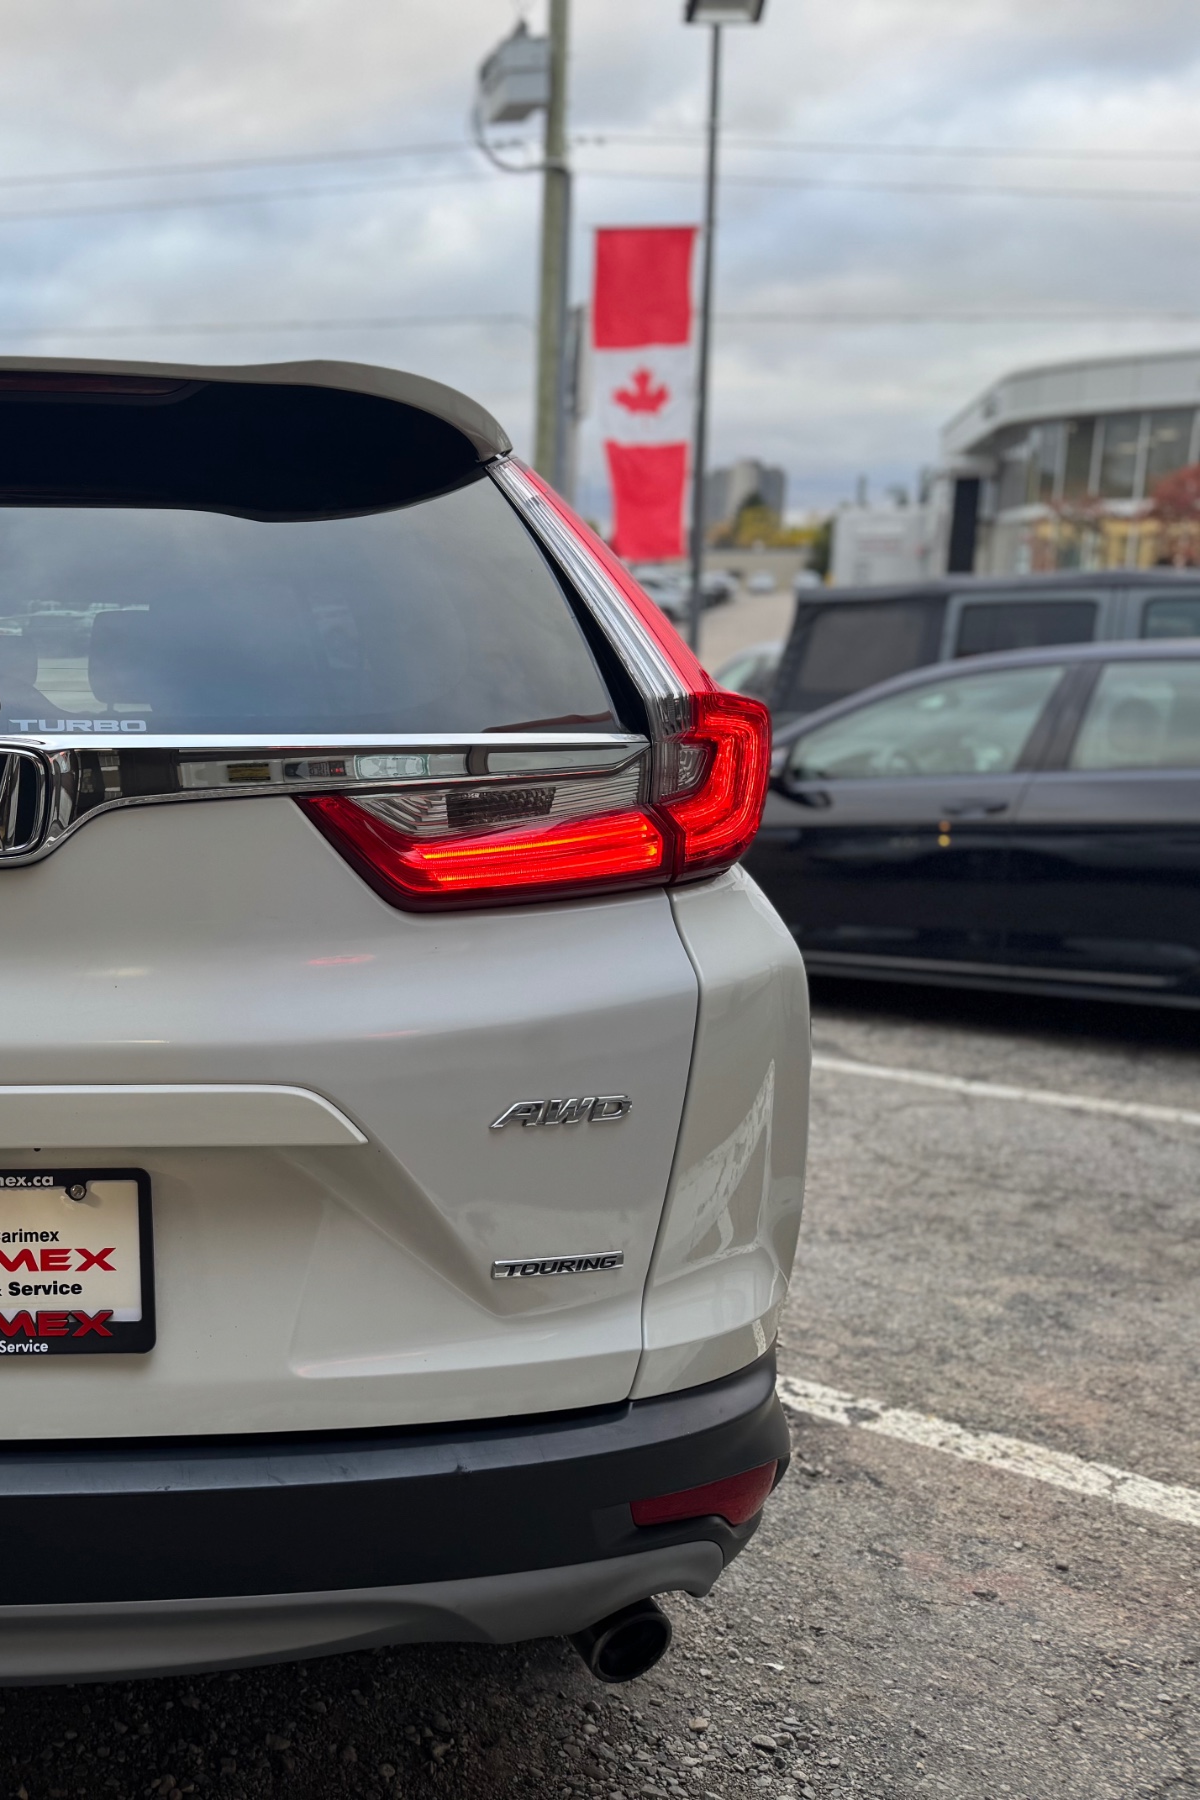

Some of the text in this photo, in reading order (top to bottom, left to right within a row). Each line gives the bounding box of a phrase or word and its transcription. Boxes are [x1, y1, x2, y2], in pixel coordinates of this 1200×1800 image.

[9, 719, 147, 732] TURBO
[489, 1094, 633, 1129] AWD
[504, 1255, 618, 1277] TOURING
[8, 1280, 83, 1297] Service
